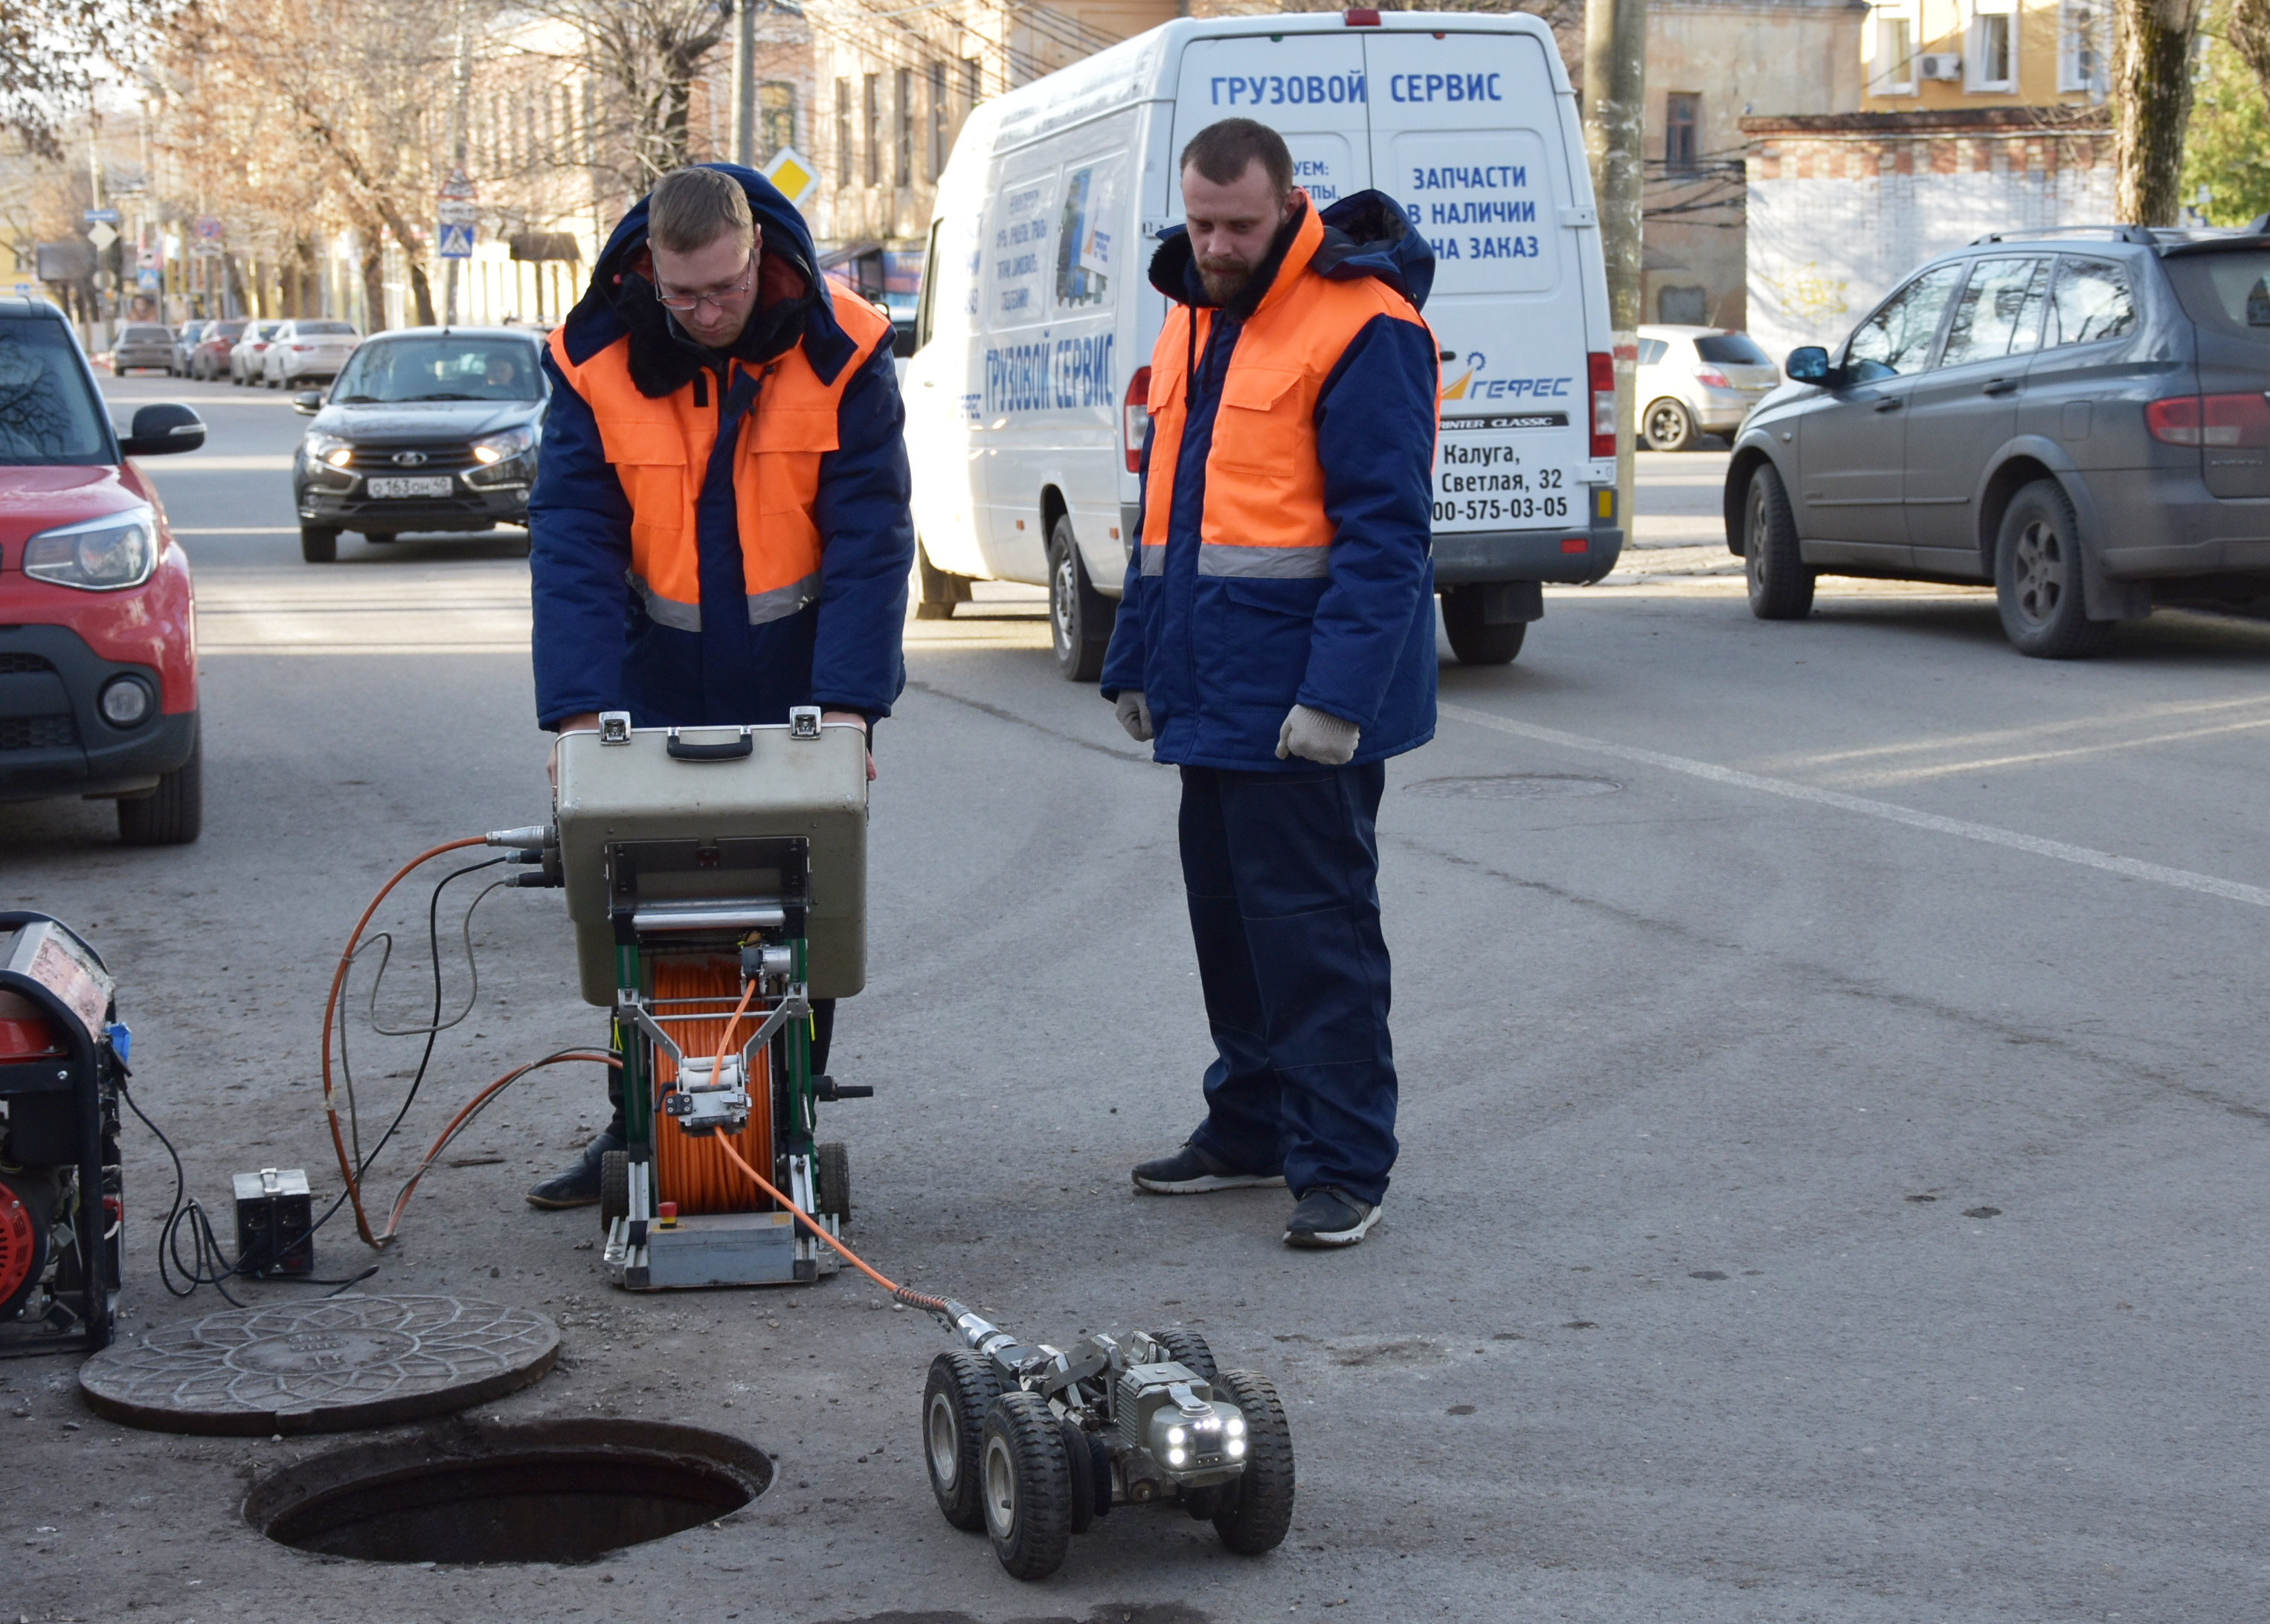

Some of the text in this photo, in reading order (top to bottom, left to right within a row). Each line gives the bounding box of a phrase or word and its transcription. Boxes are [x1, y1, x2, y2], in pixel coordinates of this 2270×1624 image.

[1211, 70, 1502, 106] ГРУЗОВОЙ СЕРВИС
[1294, 161, 1329, 176] УЕМ:
[1413, 166, 1526, 190] ЗАПЧАСТИ
[1407, 202, 1536, 225] В НАЛИЧИИ
[1431, 236, 1539, 260] НА ЗАКАЗ
[986, 329, 1113, 412] ГРУЗОВОЙ СЕРВИС
[1470, 377, 1573, 400] ГЕФЕС
[1439, 417, 1553, 429] RINTER CLASSIC
[1444, 445, 1520, 467] Калуга,
[1441, 469, 1563, 493] Светлая, 32
[1433, 497, 1568, 521] 00-575-03-05
